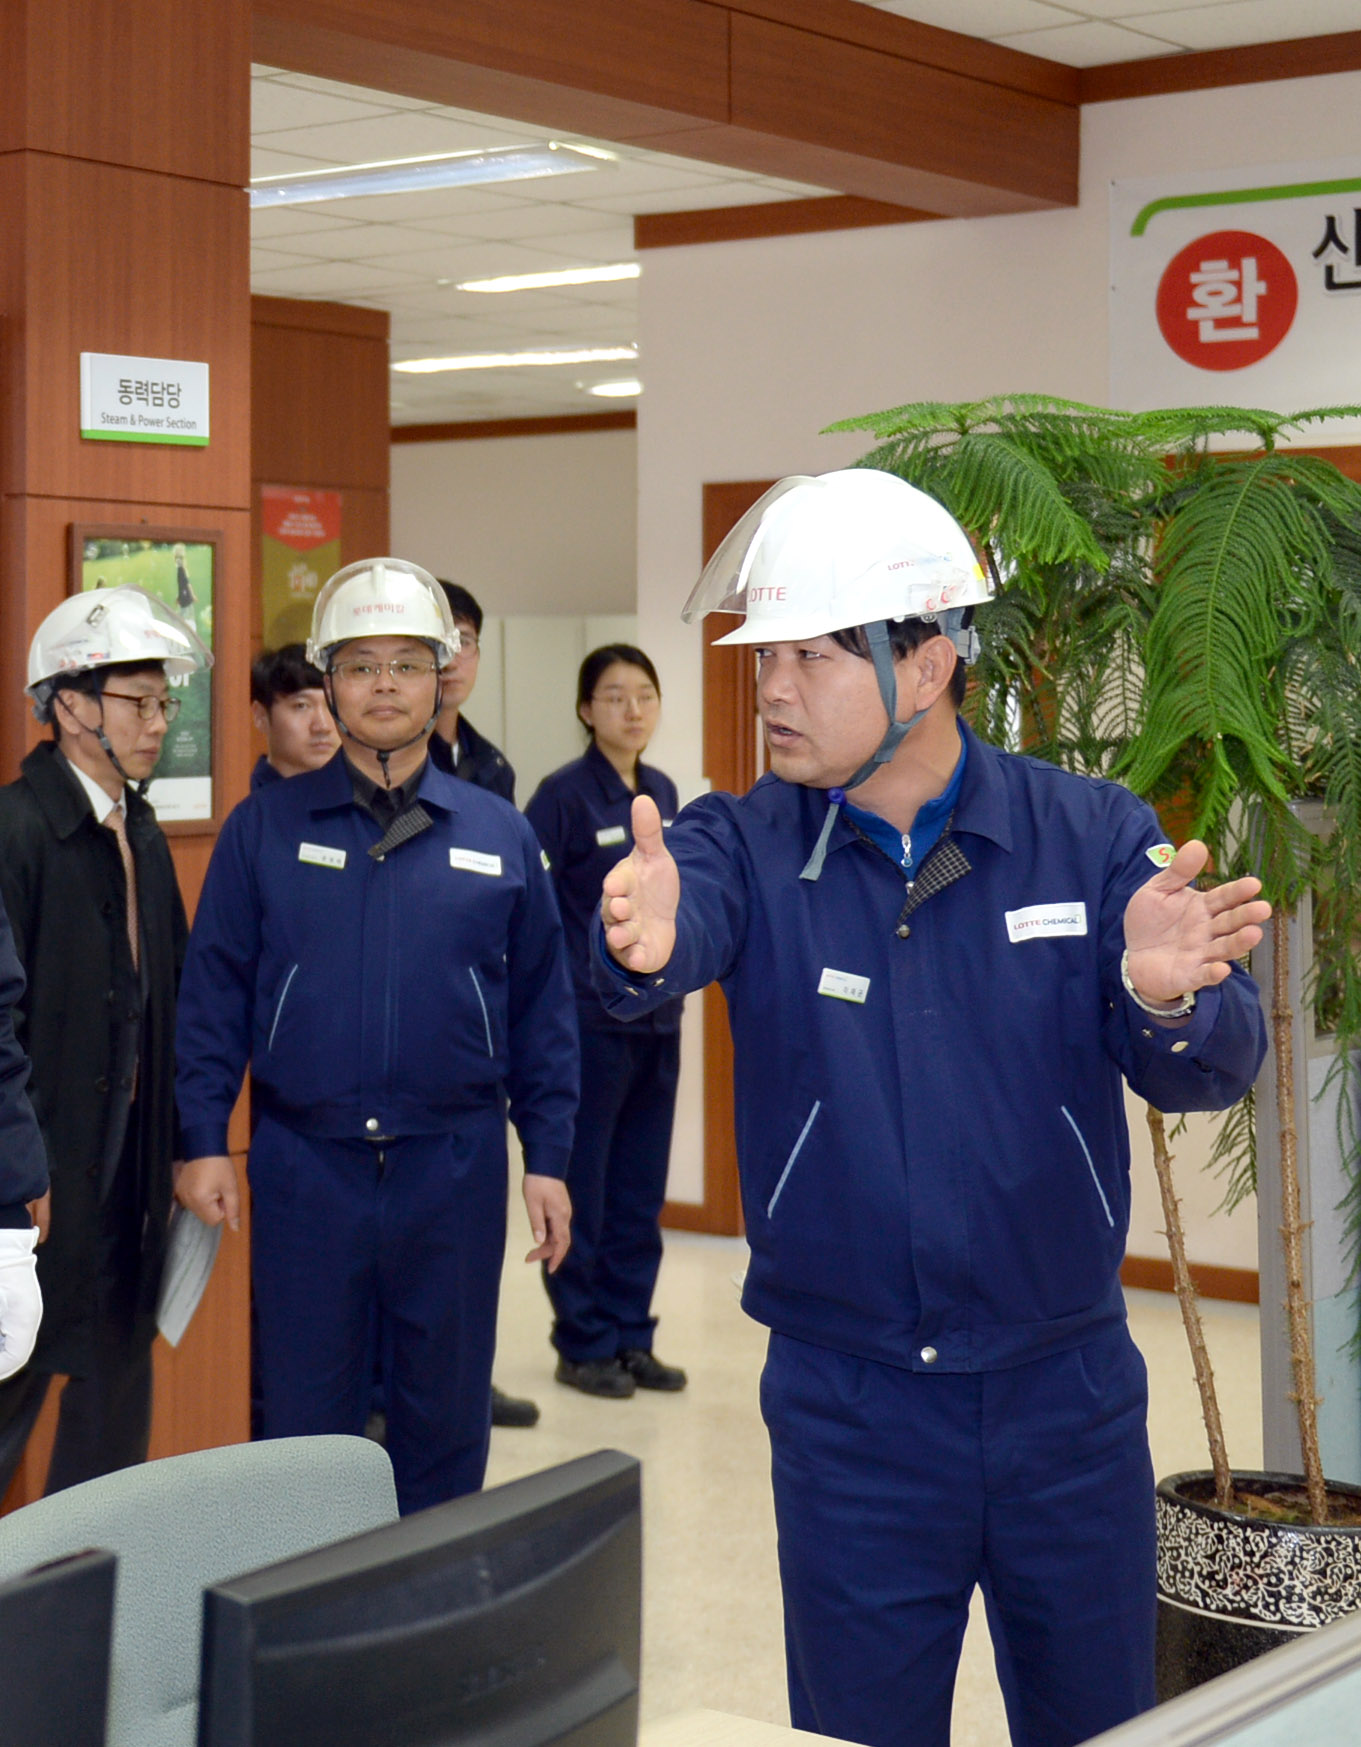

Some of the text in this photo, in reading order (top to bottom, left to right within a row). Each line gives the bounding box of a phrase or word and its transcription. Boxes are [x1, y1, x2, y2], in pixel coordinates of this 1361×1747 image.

[1186, 257, 1268, 344] 환
[117, 378, 183, 409] 동력담당
[101, 412, 197, 430] Steam & Power Section
[1158, 847, 1170, 863] S
[1013, 916, 1080, 931] LOTTE CHEMICAL
